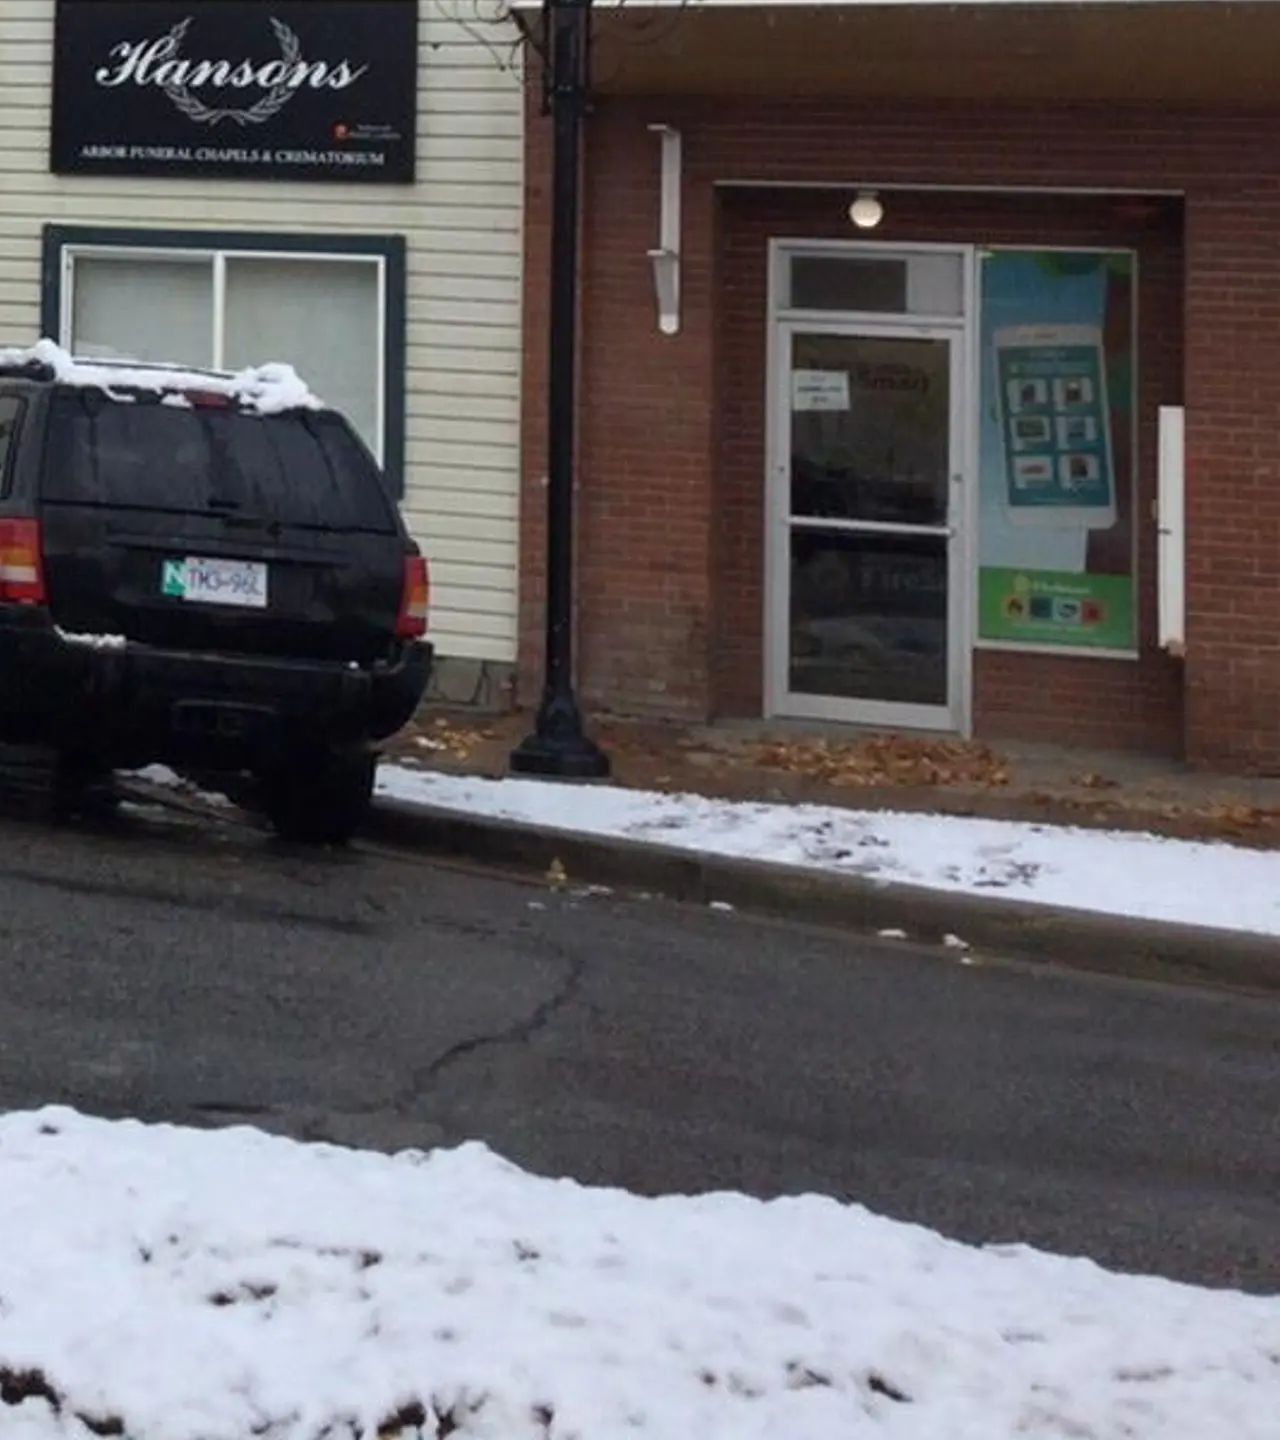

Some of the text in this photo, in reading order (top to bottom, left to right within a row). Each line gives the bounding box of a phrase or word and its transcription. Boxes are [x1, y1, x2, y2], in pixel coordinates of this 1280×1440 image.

[94, 37, 369, 90] Hansons
[80, 144, 127, 159] ARBOR
[130, 145, 192, 161] FUNERAL
[194, 147, 259, 163] CHAPELS
[274, 149, 385, 166] CREMATORIUM
